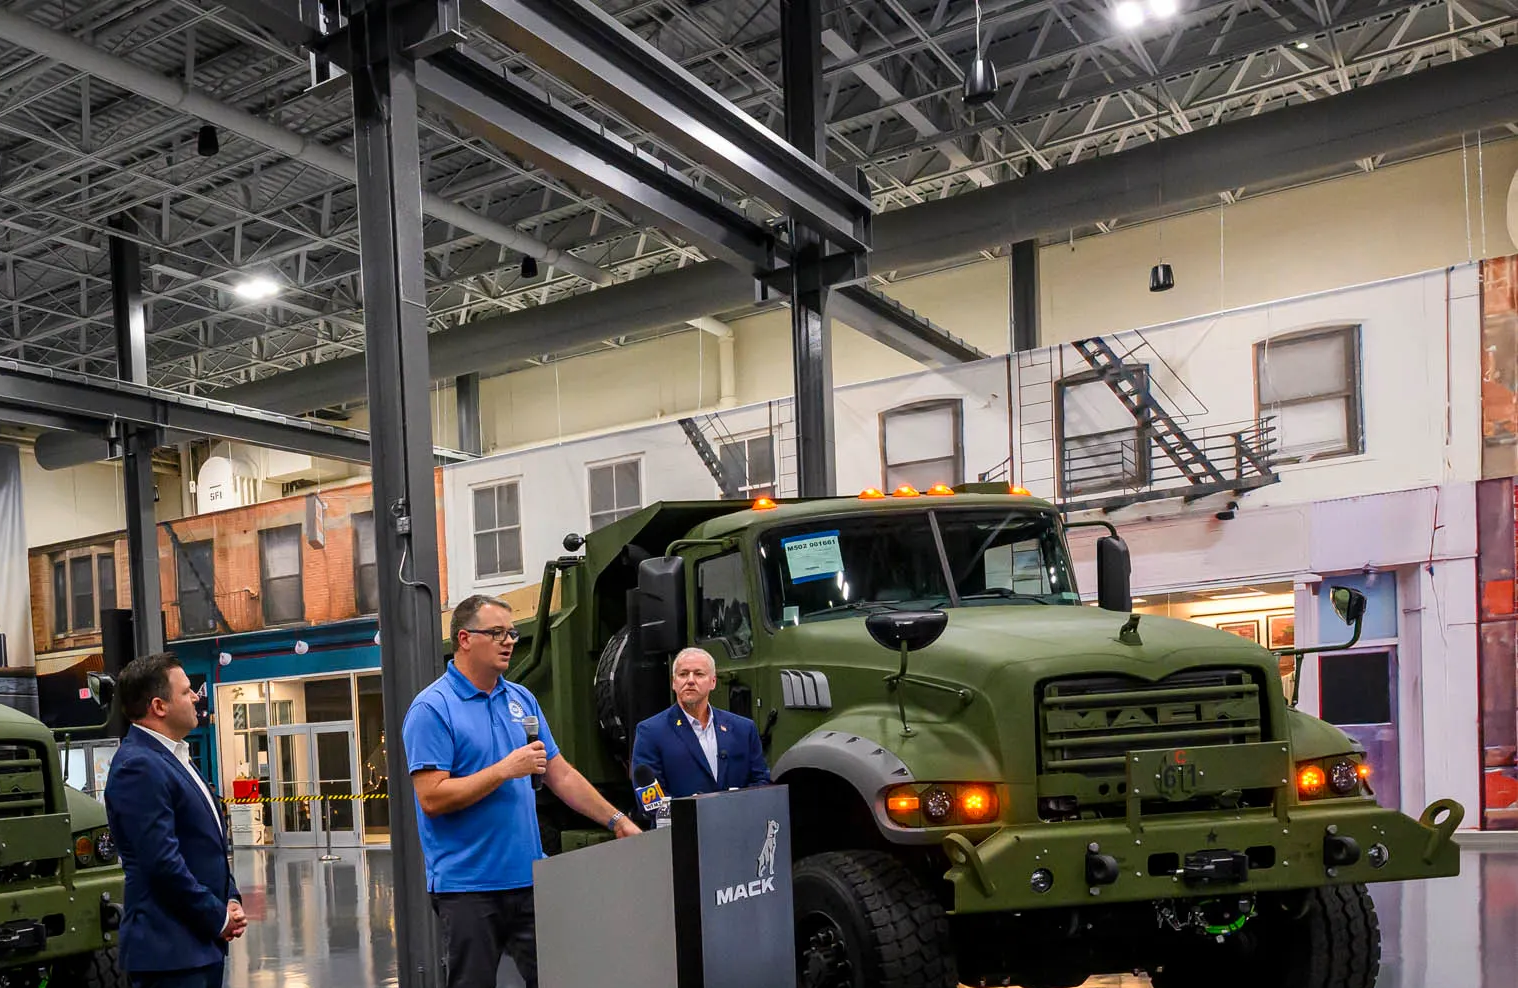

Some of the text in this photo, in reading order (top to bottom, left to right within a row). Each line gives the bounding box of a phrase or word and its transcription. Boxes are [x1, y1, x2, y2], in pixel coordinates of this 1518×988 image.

[1062, 701, 1248, 730] MACK
[1174, 750, 1186, 764] C
[1163, 763, 1197, 788] 61
[715, 876, 775, 906] MACK
